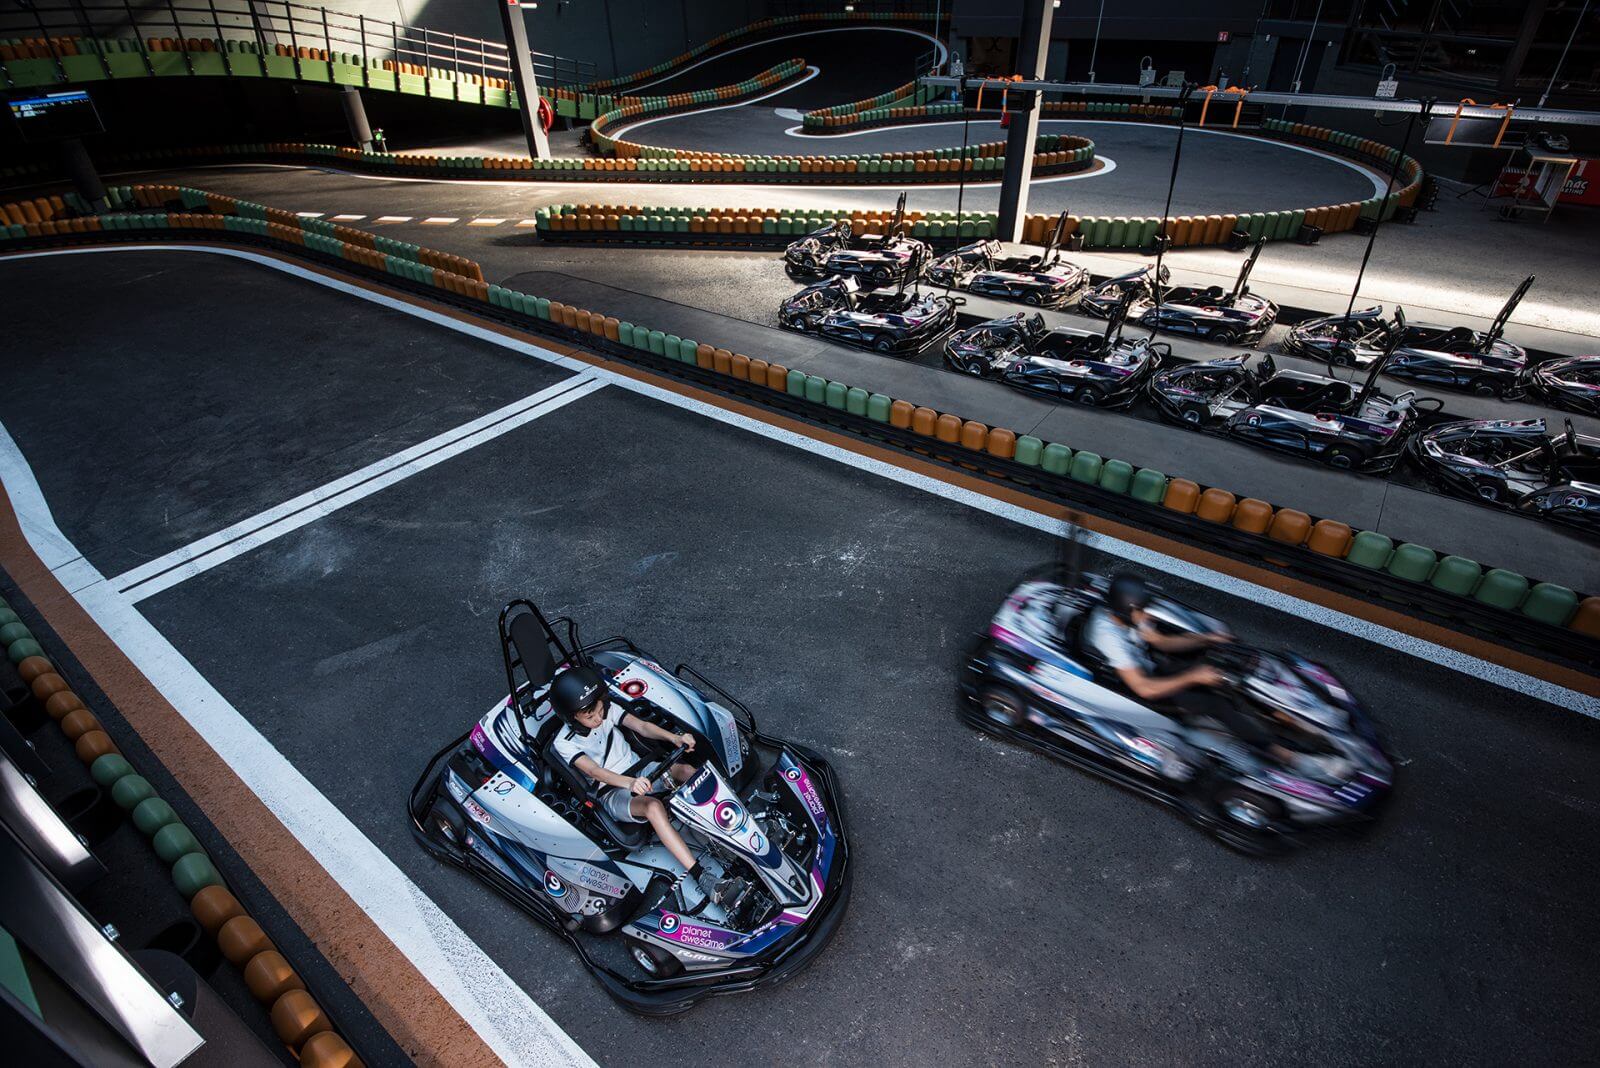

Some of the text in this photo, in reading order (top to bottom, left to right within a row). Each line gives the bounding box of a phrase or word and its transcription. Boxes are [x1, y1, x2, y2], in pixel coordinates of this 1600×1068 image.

[1249, 416, 1258, 425] 6
[1567, 496, 1586, 508] 20
[788, 770, 799, 778] 9
[803, 778, 825, 813] awesome
[720, 807, 738, 827] 9
[582, 866, 610, 882] planet
[548, 875, 561, 890] 9
[580, 875, 621, 894] awesome
[663, 917, 676, 929] 9
[681, 926, 712, 939] planet
[680, 934, 725, 949] awesome
